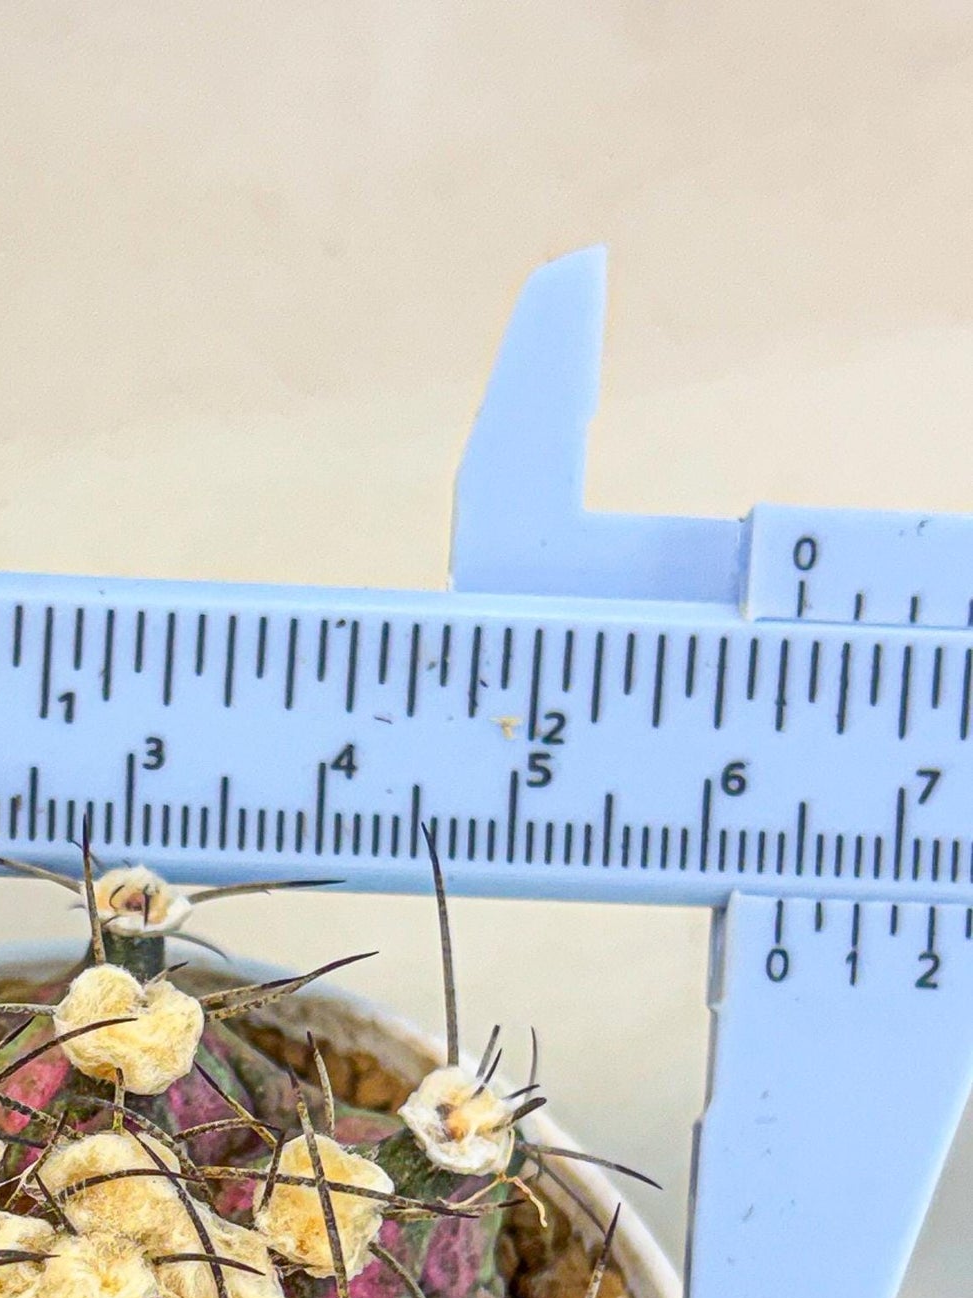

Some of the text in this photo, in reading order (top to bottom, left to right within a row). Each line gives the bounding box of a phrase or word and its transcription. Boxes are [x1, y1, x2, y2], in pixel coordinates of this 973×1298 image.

[794, 537, 818, 572] 0
[58, 692, 75, 724] 1
[542, 711, 566, 746] 2
[142, 736, 166, 771] 3
[331, 743, 358, 779] 4
[526, 753, 553, 788] 5
[720, 762, 747, 797] 6
[916, 769, 942, 805] 7
[765, 948, 941, 989] 0 1 2
